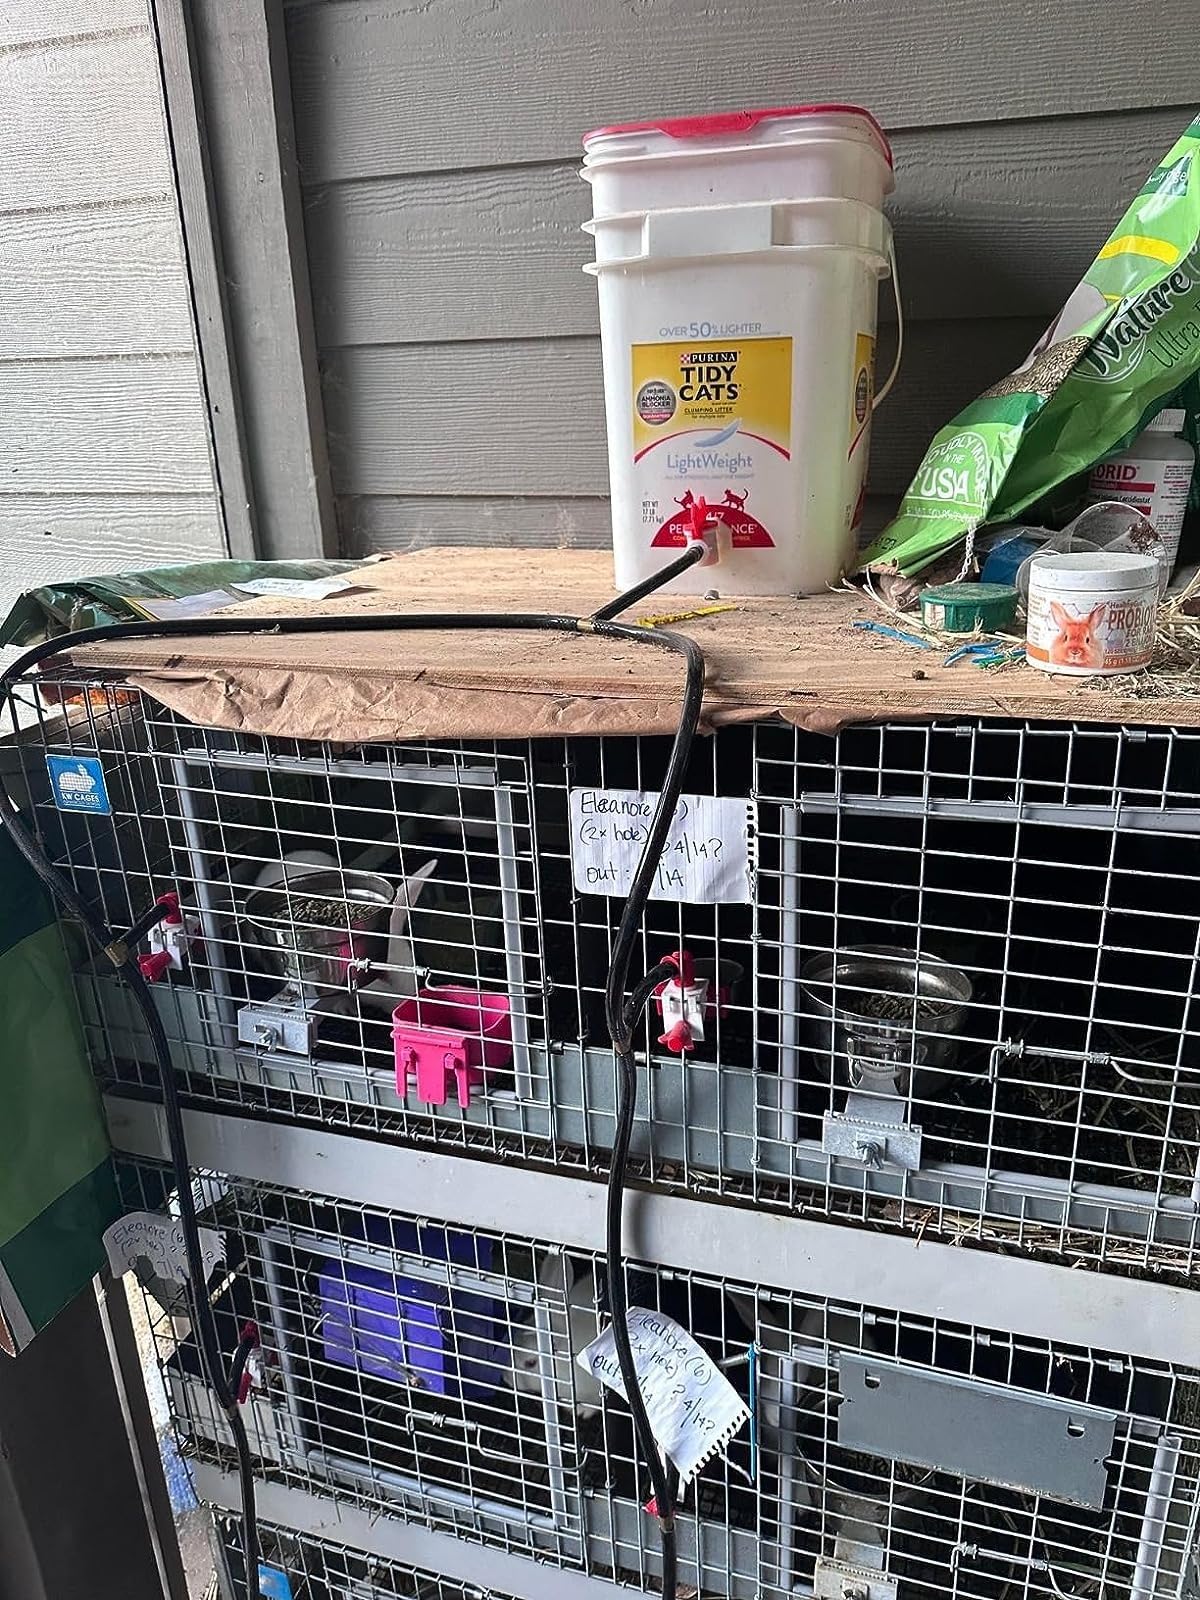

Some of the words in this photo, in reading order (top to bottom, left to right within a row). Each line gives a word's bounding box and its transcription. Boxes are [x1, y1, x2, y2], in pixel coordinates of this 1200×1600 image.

[659, 327, 688, 337] OVER
[721, 323, 762, 334] LIGHTER
[1085, 271, 1191, 375] Nature
[1147, 321, 1200, 368] Ultra
[692, 353, 736, 362] PURINA
[680, 365, 737, 383] TIDY
[679, 384, 738, 401] CATS
[667, 453, 752, 474] LightWeight
[1095, 465, 1137, 480] ORID
[920, 467, 969, 502] USA
[74, 794, 99, 802] CAGES
[581, 791, 651, 817] Eleanore
[657, 863, 683, 890] /14
